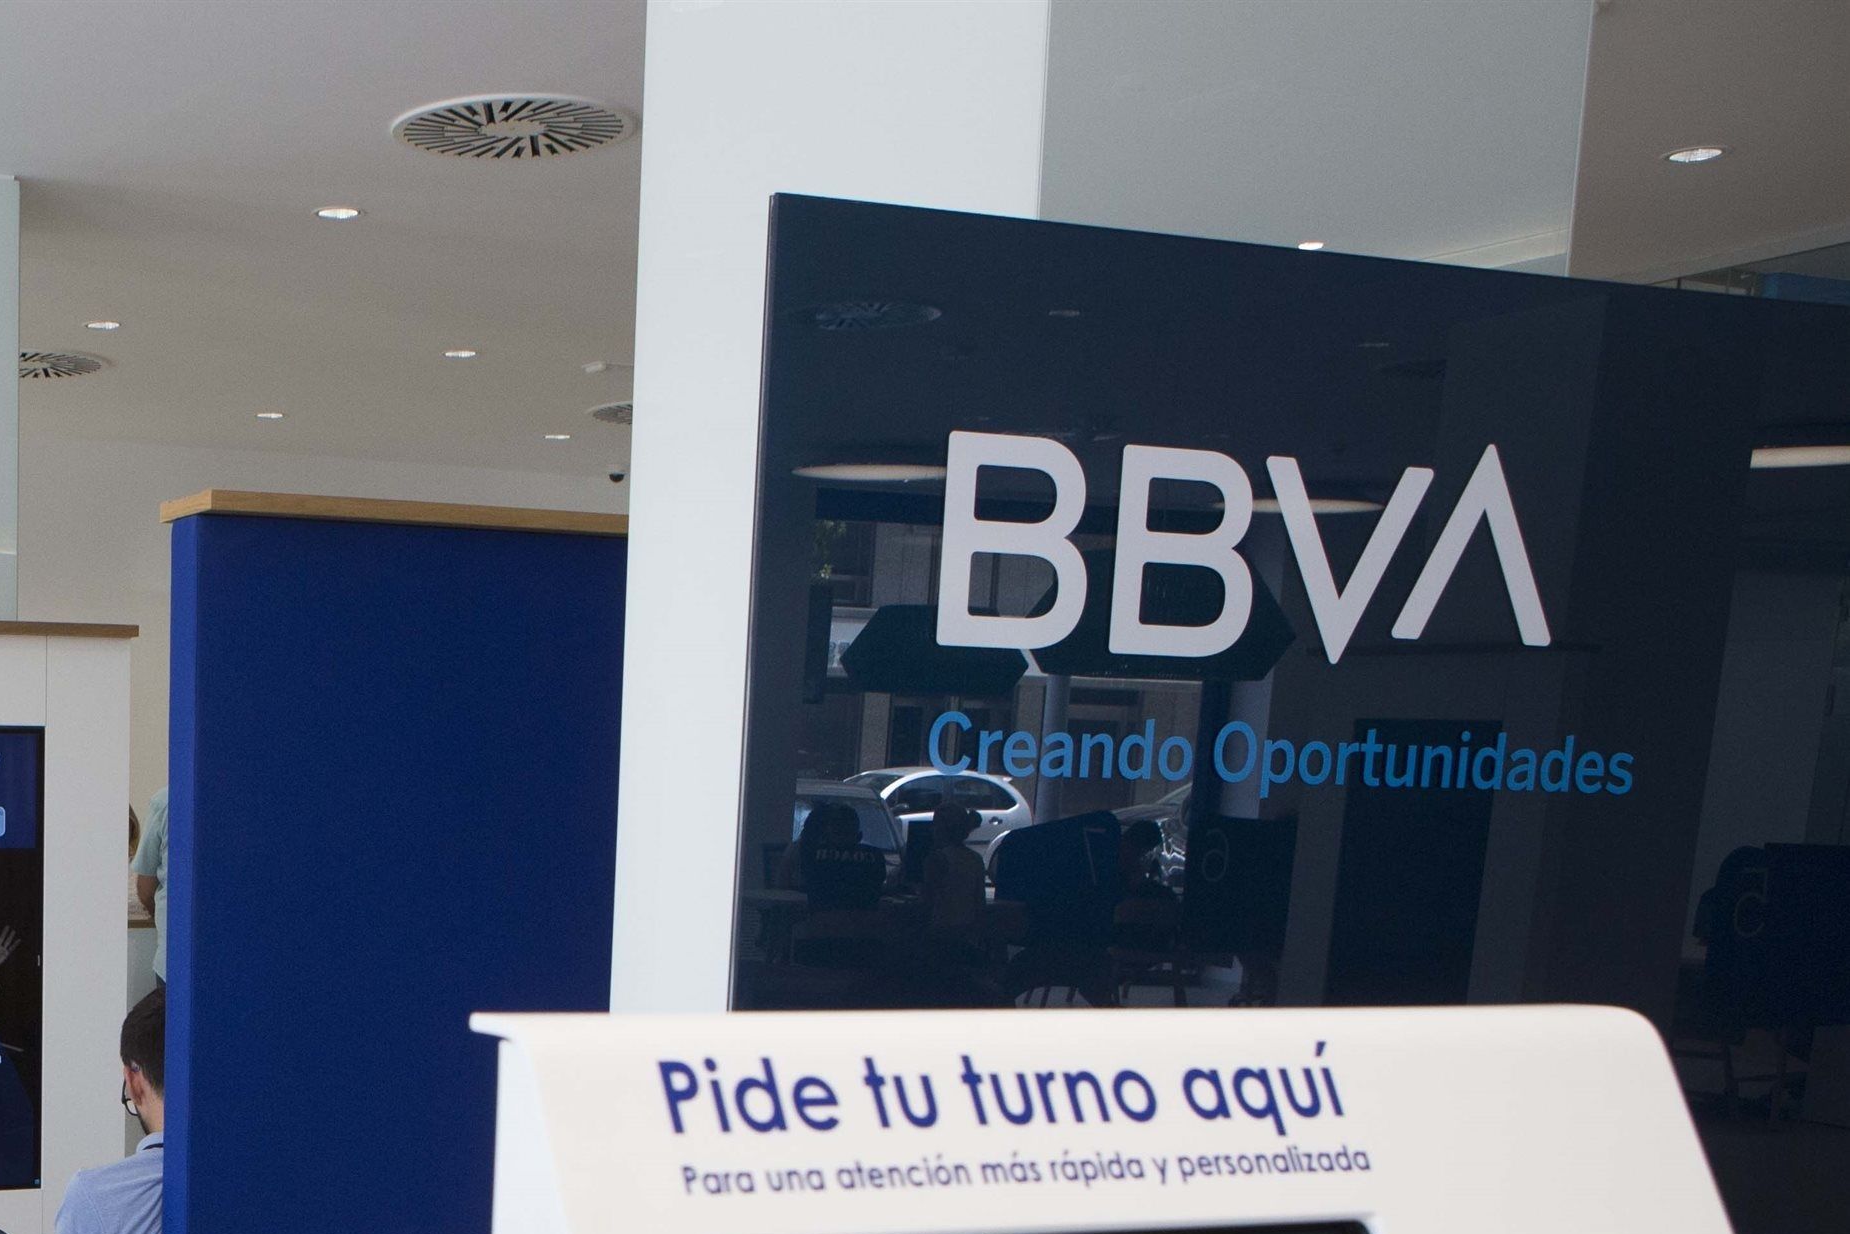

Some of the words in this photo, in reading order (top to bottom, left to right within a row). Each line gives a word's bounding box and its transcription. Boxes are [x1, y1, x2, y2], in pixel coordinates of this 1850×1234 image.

[936, 430, 1551, 665] BBVA
[928, 711, 1194, 784] Creando
[1213, 721, 1635, 799] Oportunidades
[658, 1056, 840, 1133] Pide
[865, 1056, 938, 1129] tu
[962, 1054, 1158, 1126] turno
[1182, 1041, 1345, 1136] aquí
[683, 1166, 756, 1195] Para
[766, 1168, 827, 1193] una
[836, 1155, 972, 1189] atención
[982, 1151, 1042, 1185] más
[1051, 1149, 1145, 1190] rápida
[1153, 1157, 1170, 1184] y
[1179, 1146, 1371, 1183] personalizada
